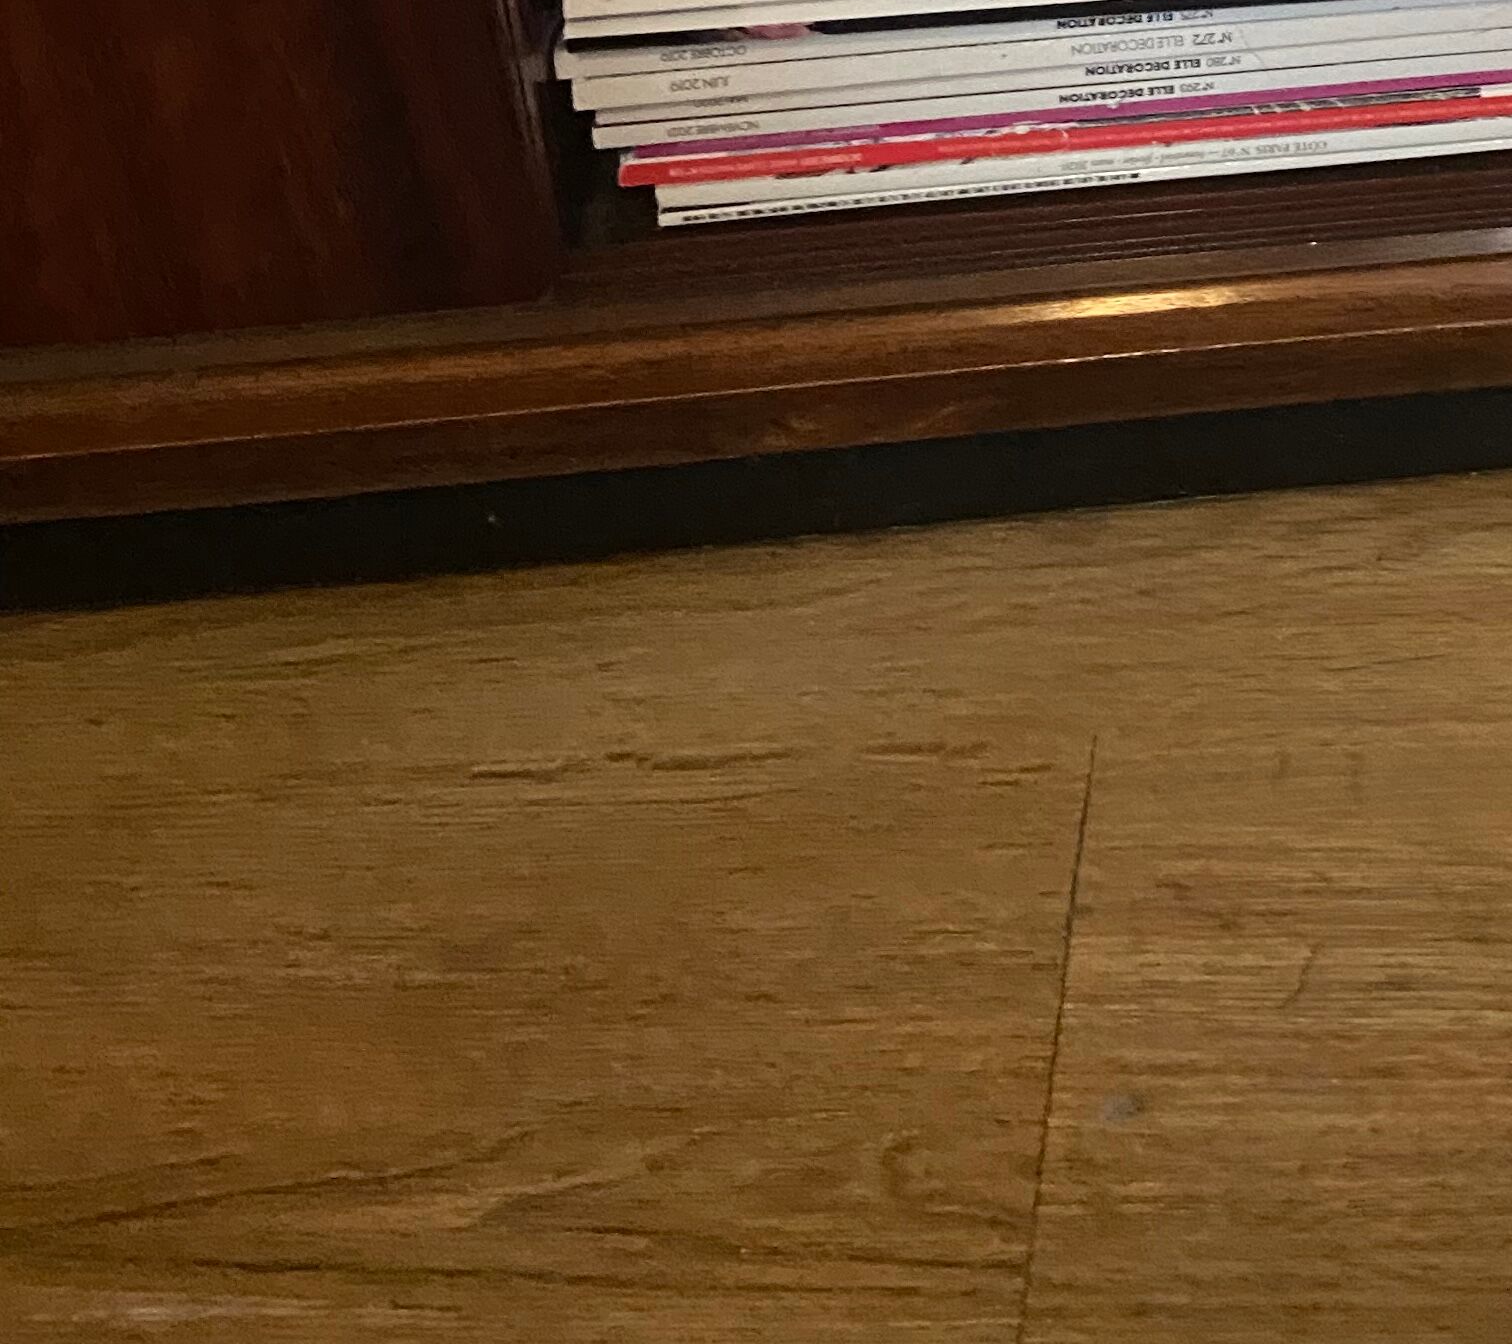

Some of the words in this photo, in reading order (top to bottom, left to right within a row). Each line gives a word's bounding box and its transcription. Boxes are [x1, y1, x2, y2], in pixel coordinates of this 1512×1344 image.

[1056, 14, 1145, 30] DECORATION
[1147, 11, 1174, 23] ELLE
[1155, 34, 1185, 47] ELLE
[1192, 31, 1233, 46] N°272
[690, 44, 748, 59] OCTOBRE
[1070, 37, 1157, 57] DECORATION
[1084, 59, 1171, 77] DECORATION
[1173, 56, 1201, 70] ELLE
[668, 78, 699, 93] 2019
[702, 74, 731, 88] JUIN
[1058, 88, 1144, 104] DECORATION
[1147, 84, 1175, 96] ELLE
